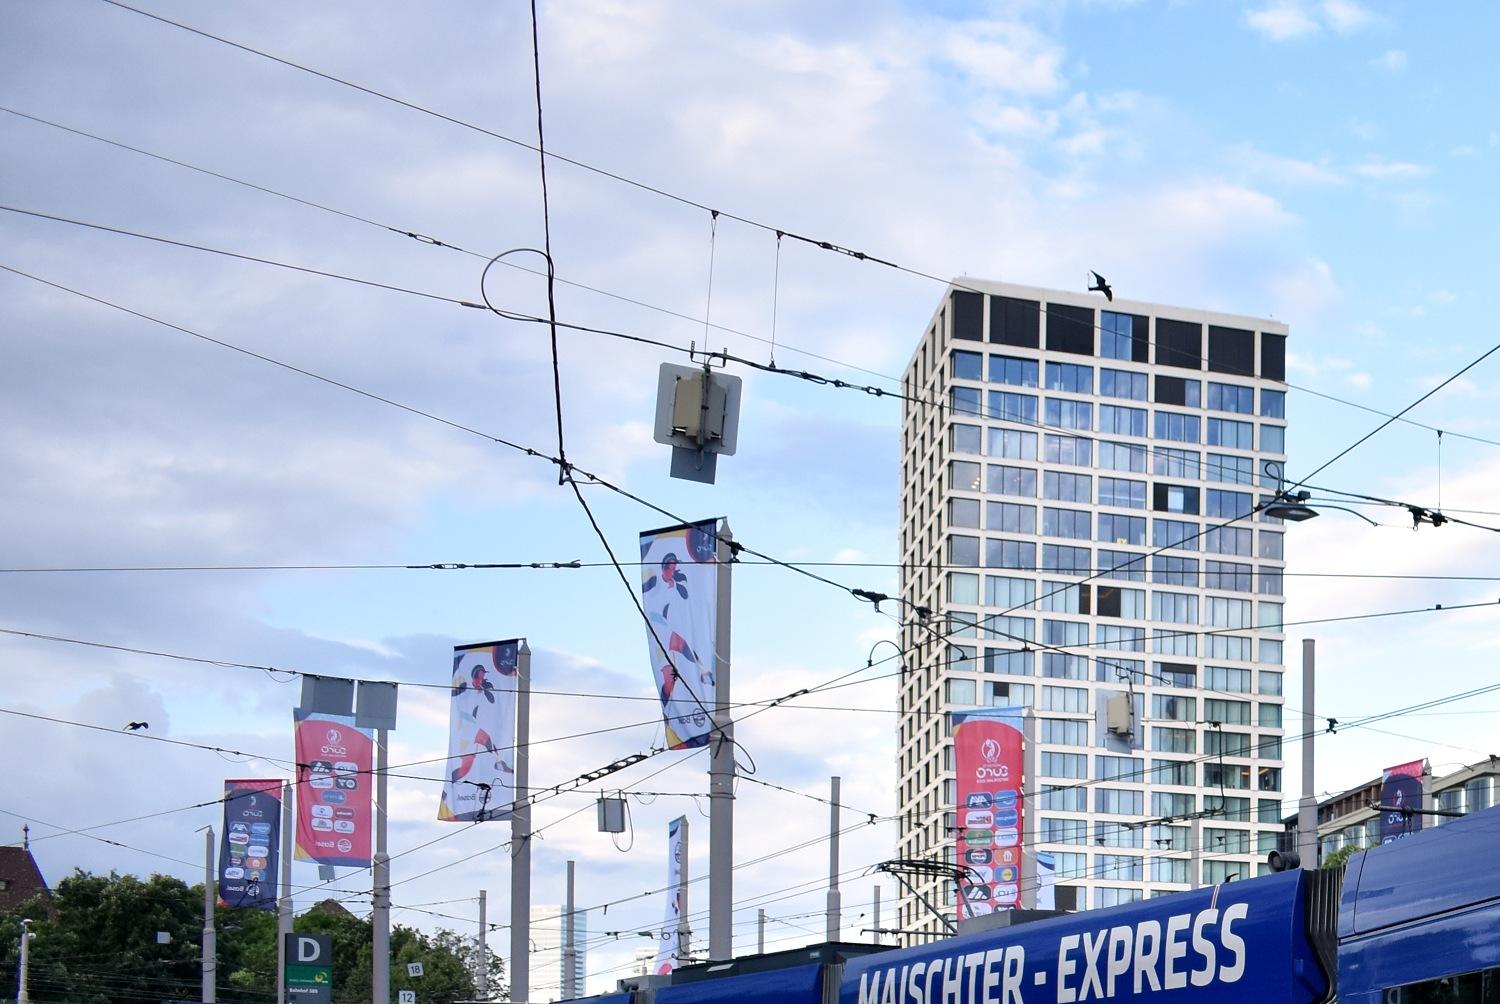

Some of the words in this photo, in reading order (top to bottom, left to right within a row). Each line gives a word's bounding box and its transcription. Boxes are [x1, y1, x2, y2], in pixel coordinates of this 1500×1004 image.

[298, 937, 321, 962] D
[1057, 902, 1249, 1004] EXPRESS
[409, 964, 421, 977] 18
[402, 991, 414, 1003] 12
